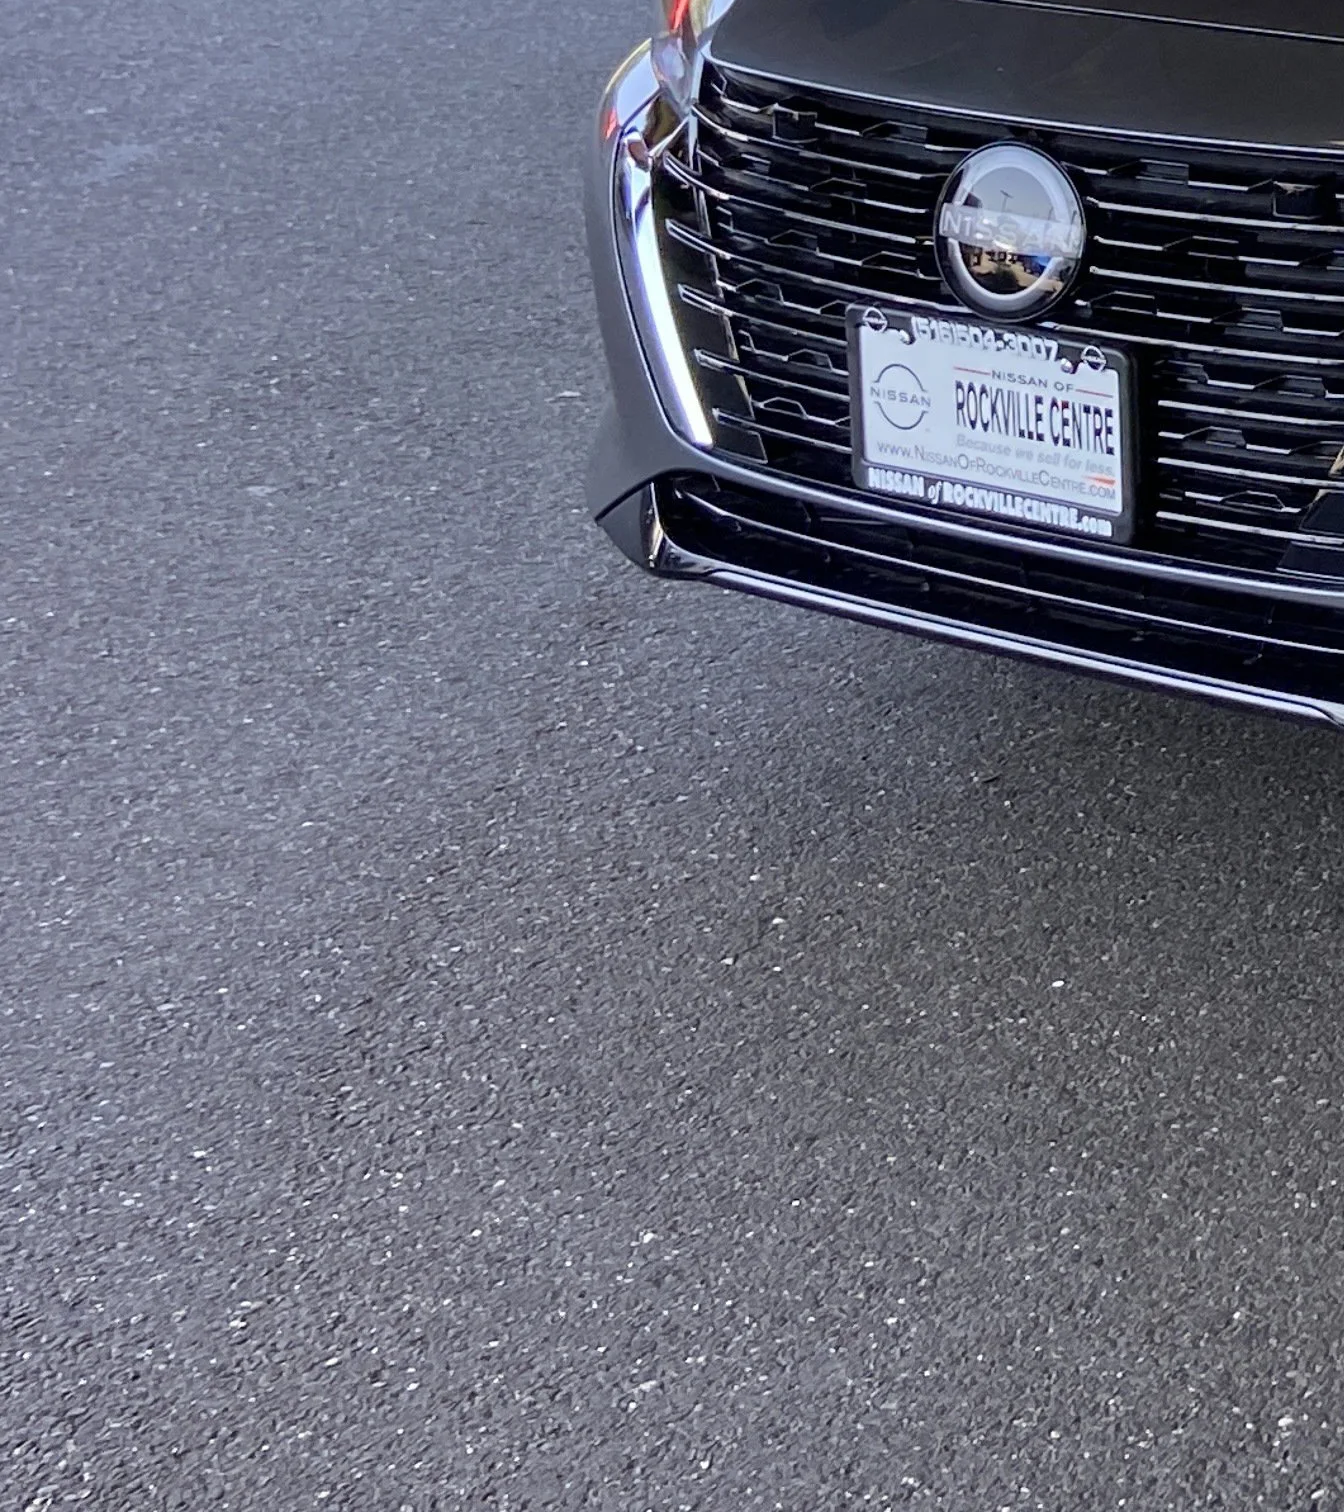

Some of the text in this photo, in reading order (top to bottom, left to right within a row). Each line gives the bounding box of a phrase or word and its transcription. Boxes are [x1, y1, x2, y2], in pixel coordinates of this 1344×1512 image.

[943, 209, 1077, 254] NISSAN
[870, 386, 931, 407] NISSAN
[991, 369, 1074, 393] NISSAN OF
[954, 379, 1115, 455] ROCKVILLE CENTRE
[956, 434, 1011, 456] Because
[1063, 454, 1083, 470] for
[868, 467, 1113, 537] NISSAN of ROCKVILLECENTRE.com
